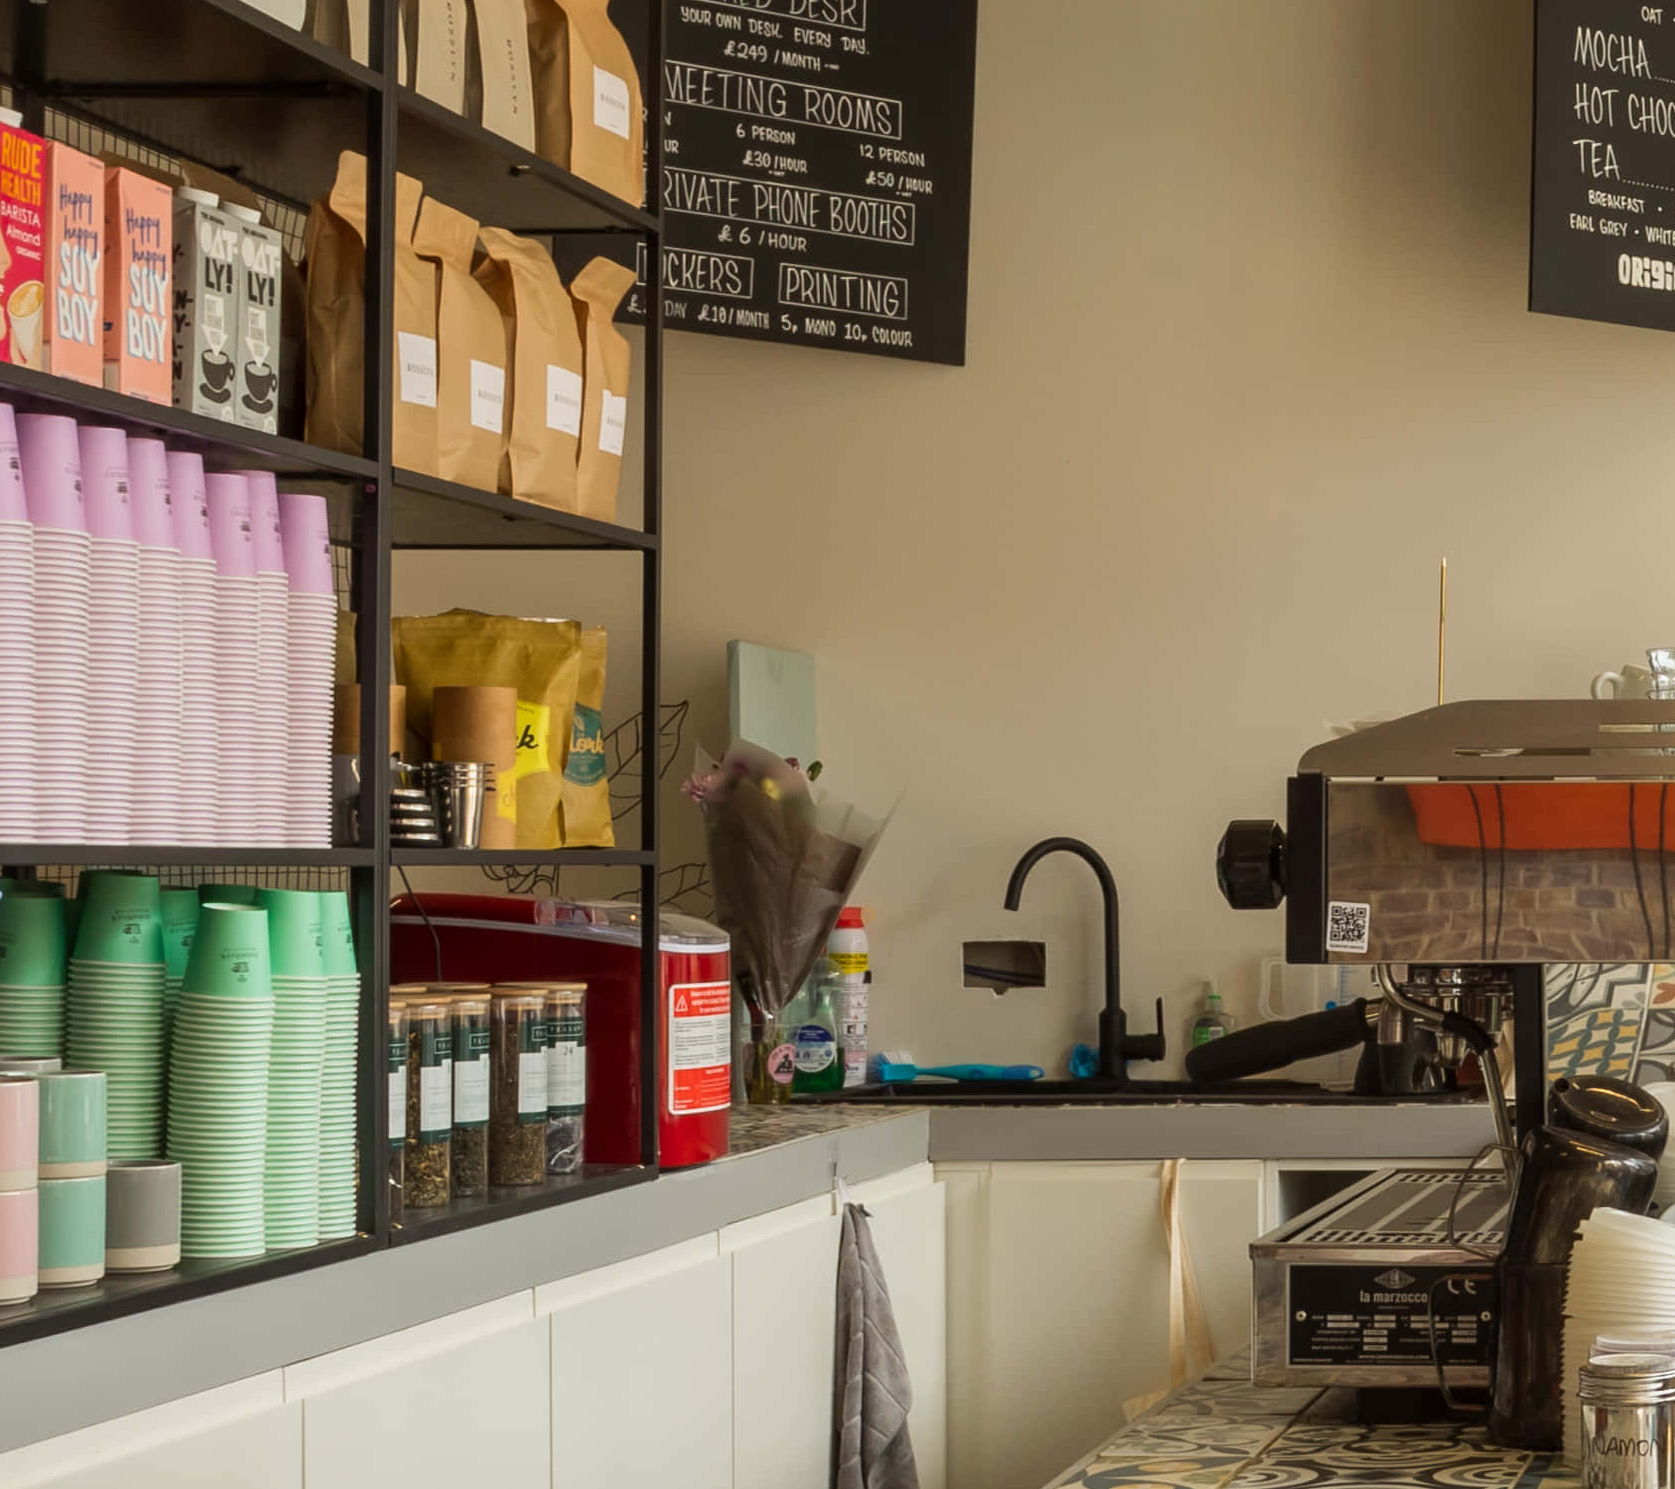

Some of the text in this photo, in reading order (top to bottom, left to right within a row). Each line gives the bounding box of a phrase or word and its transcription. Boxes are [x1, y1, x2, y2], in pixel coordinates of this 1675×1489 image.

[680, 5, 712, 27] YOUR
[716, 14, 742, 31] OWN
[794, 28, 832, 48] EVERY
[1641, 5, 1663, 25] OAT
[1574, 25, 1653, 80] MOCHA
[804, 88, 893, 135] ROOMS
[1574, 82, 1620, 128] HOT
[1, 131, 43, 179] RUDE
[736, 123, 796, 145] 6 PERSON
[860, 144, 925, 168] 12 PERSON
[1572, 138, 1621, 181] TEA
[0, 168, 41, 207] HEALTH
[59, 183, 93, 224] Happy
[664, 169, 908, 241] RIVATE PHONE BOOTHS
[1587, 189, 1646, 214] BREAKFAST
[0, 201, 41, 227] BARISTA
[6, 224, 41, 246] Almond
[125, 208, 161, 248] Happy
[1569, 213, 1595, 233] EARL
[1599, 220, 1628, 239] GREY
[63, 215, 99, 260] happy
[59, 242, 101, 297] SOY
[132, 238, 166, 281] happy
[204, 256, 233, 294] LY!
[130, 263, 169, 317] SOY
[247, 271, 275, 307] LY!
[785, 267, 900, 317] PRINTING
[56, 287, 98, 347] BOY
[127, 308, 167, 364] BOY
[805, 316, 836, 337] MONO
[872, 325, 913, 347] COLOUR
[1360, 1290, 1428, 1304] la marzocco
